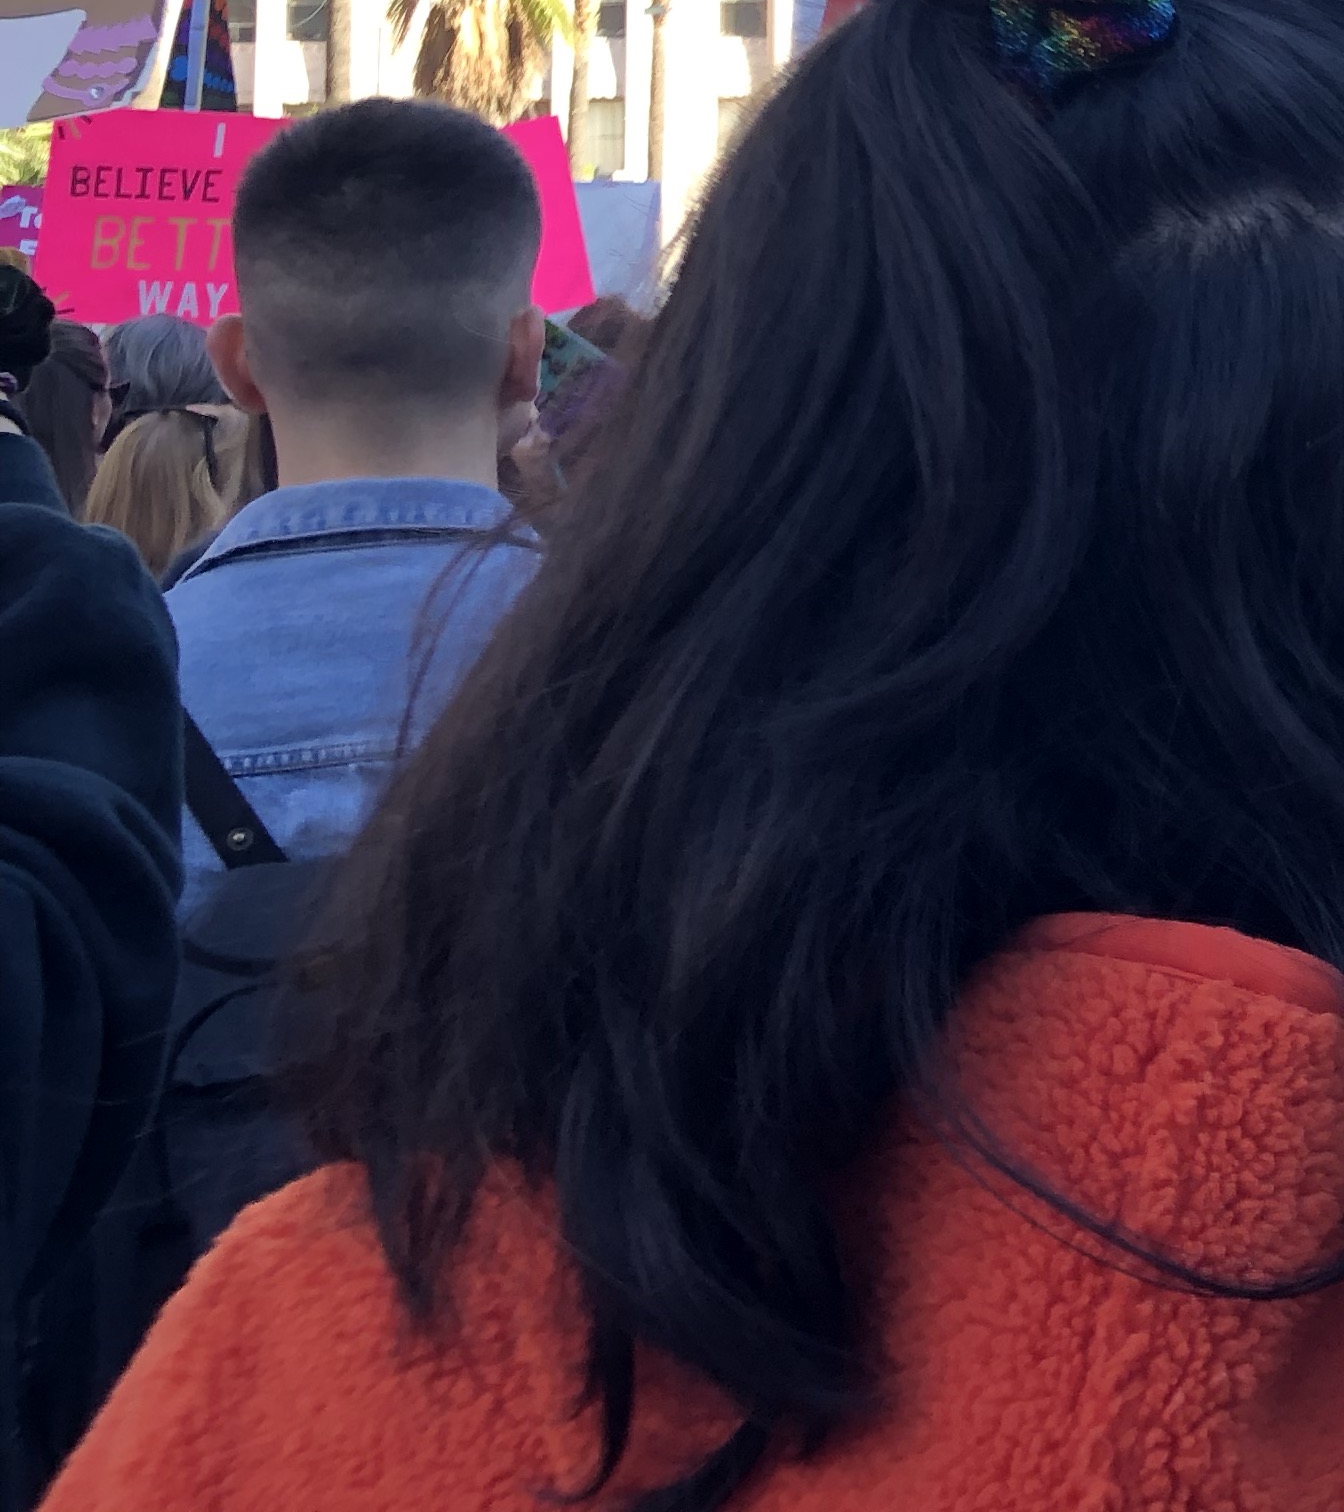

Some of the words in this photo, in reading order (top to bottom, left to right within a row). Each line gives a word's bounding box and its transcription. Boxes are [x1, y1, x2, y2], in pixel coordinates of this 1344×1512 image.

[213, 122, 227, 159] I
[69, 165, 223, 203] BELIEVE
[137, 279, 229, 319] WAY
